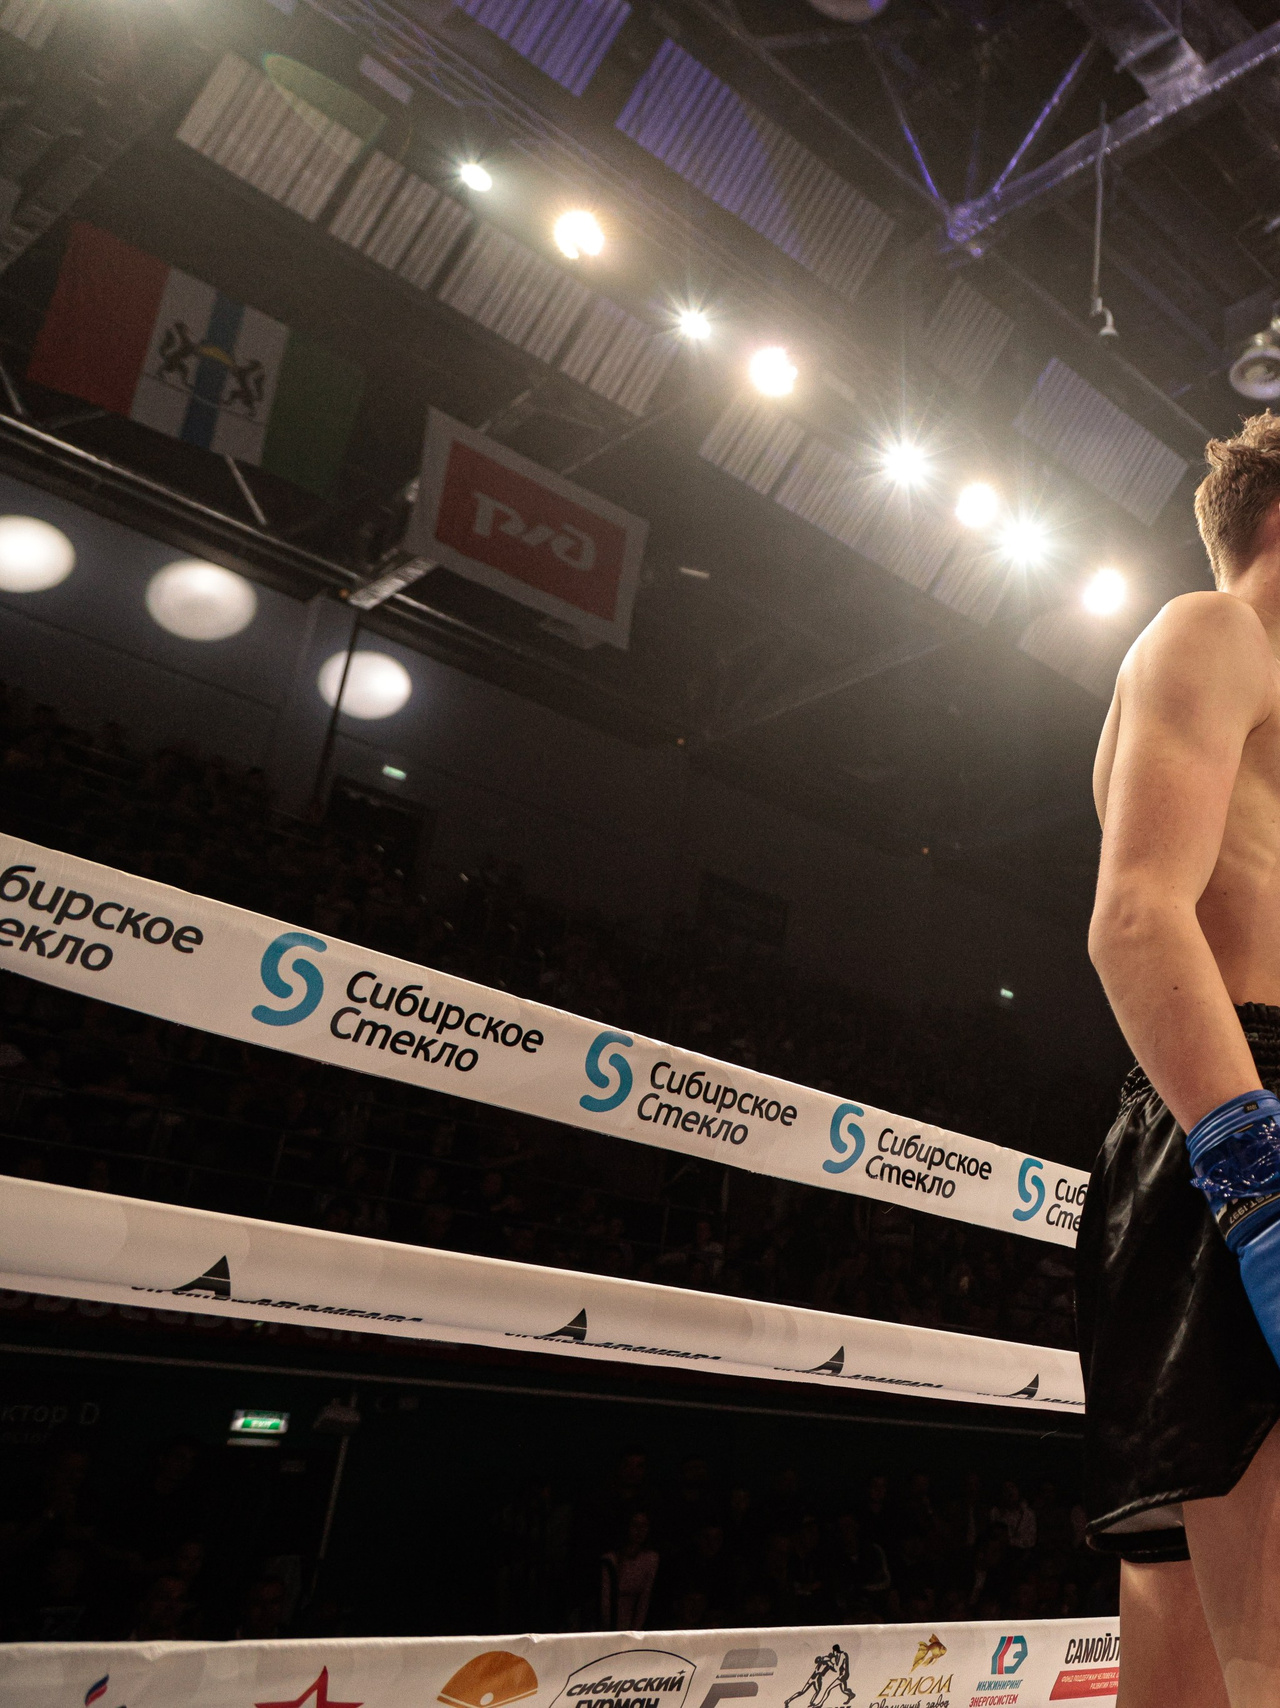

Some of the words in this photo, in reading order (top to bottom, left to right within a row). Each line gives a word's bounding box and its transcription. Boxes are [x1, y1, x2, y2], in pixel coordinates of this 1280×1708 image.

[345, 970, 545, 1054] Сибирское
[329, 1006, 480, 1072] Стекло
[636, 1093, 748, 1145] Стекло
[649, 1061, 798, 1127] Сибирское
[864, 1156, 956, 1199] Стекло
[877, 1128, 992, 1180] Сибирское
[566, 1671, 686, 1698] сибирский
[969, 1694, 1018, 1708] ЭНЕРГОСИСТЕМ
[976, 1680, 1023, 1692] ИНЖИНИРИНГ
